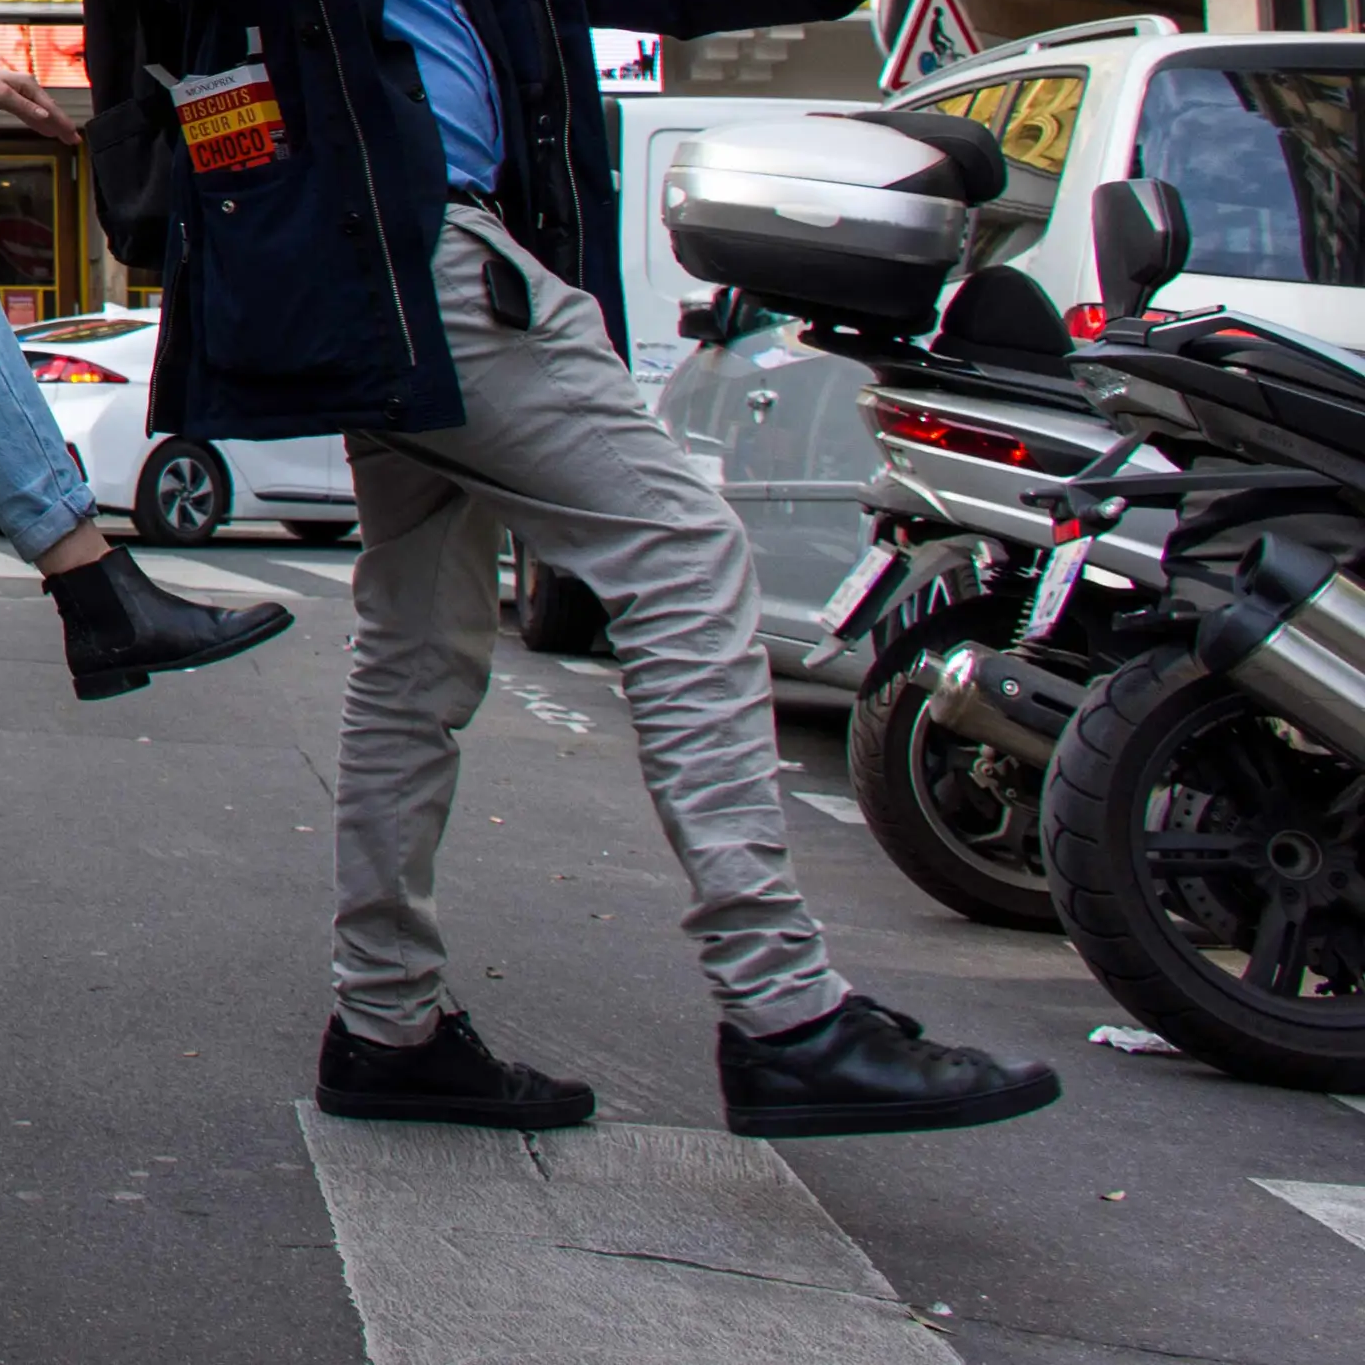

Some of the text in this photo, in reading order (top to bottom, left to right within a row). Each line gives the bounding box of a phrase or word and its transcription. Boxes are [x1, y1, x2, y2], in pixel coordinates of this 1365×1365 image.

[185, 75, 236, 97] MONOPRIX
[183, 88, 251, 121] BISCUITS
[188, 108, 257, 140] CŒUR AU
[196, 128, 266, 168] CHOCO
